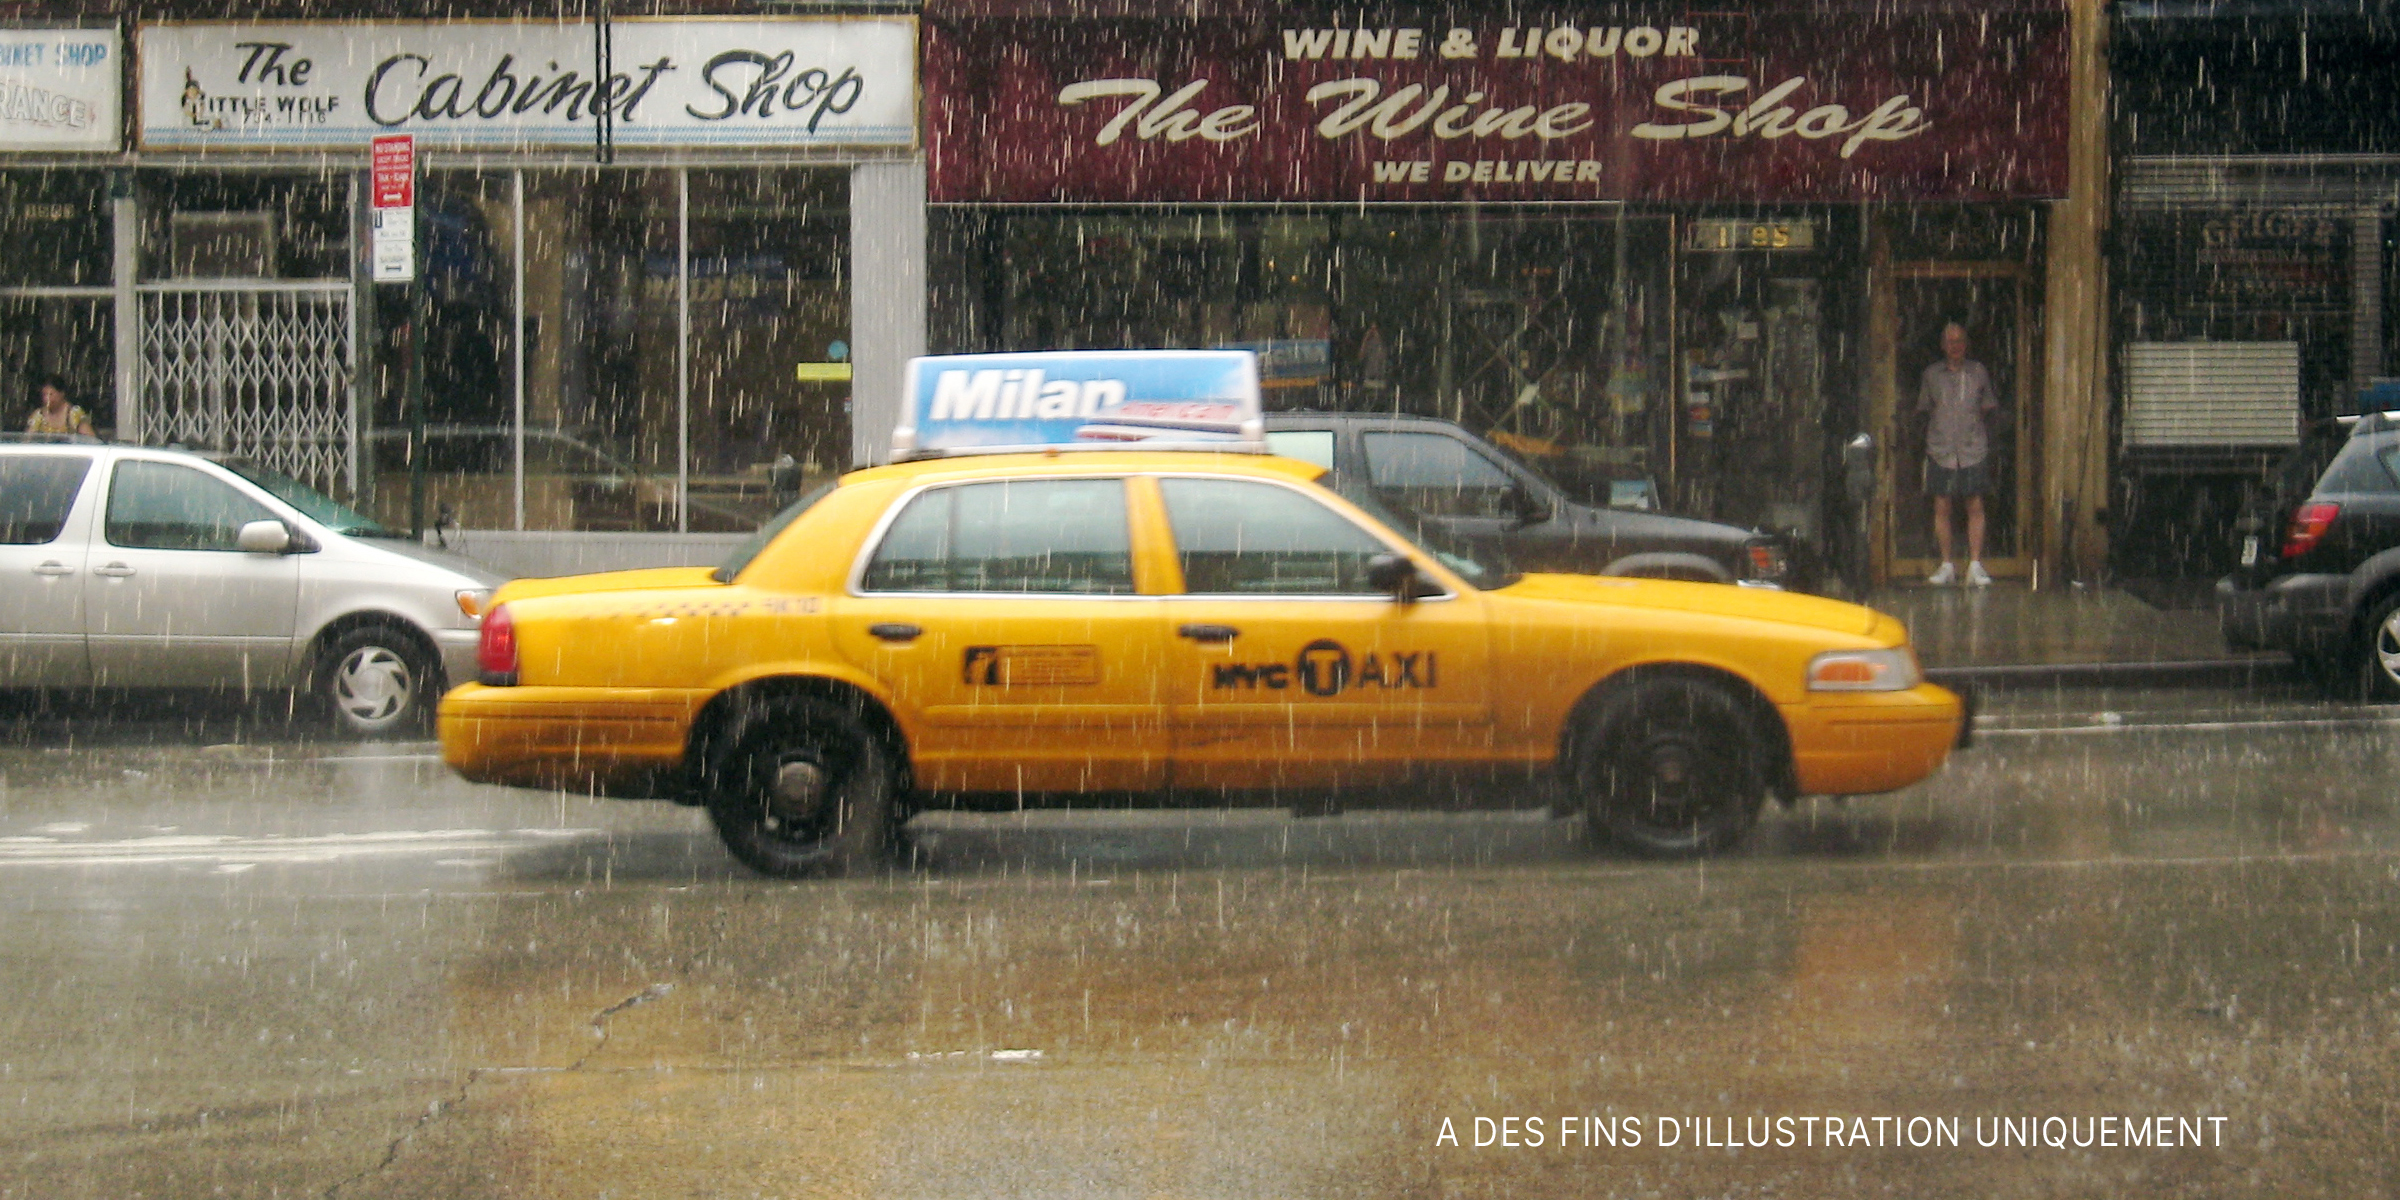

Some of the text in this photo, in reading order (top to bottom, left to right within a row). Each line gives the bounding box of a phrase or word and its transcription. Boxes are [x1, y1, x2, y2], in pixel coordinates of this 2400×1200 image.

[55, 43, 107, 66] SHOP
[235, 42, 313, 86] The
[1283, 27, 1701, 62] WINE & LIQUOR
[365, 49, 864, 134] Cabinet Shop
[1058, 75, 1933, 159] The Wine Shop
[1373, 160, 1601, 183] WE DELIVER
[929, 367, 1127, 421] Milan
[1214, 641, 1437, 695] NYC TAXI
